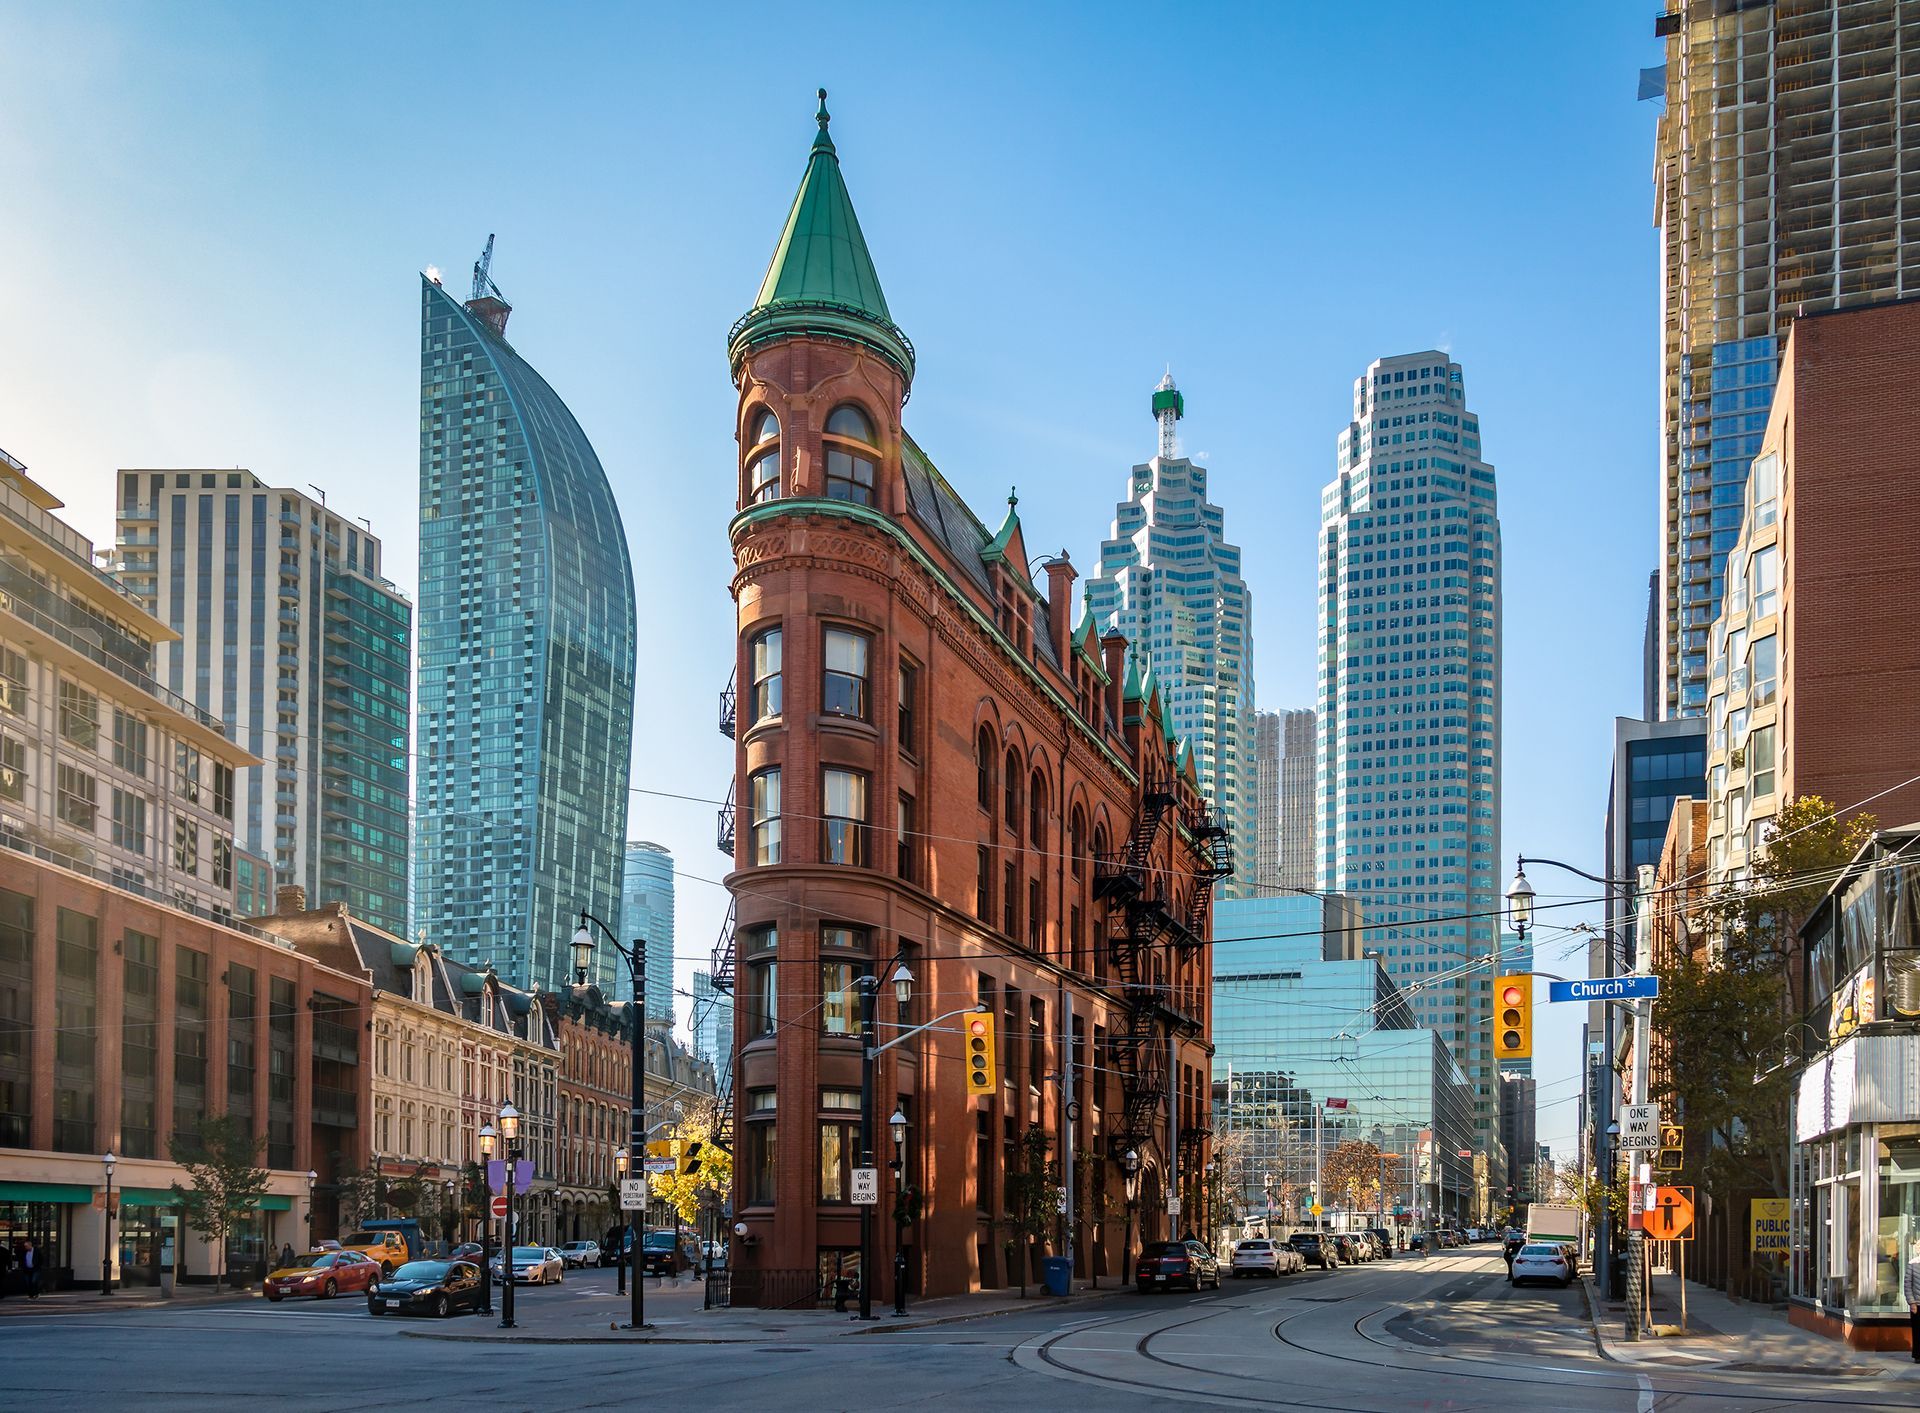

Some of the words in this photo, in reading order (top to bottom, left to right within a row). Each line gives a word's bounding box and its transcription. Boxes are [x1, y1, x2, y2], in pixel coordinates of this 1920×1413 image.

[1570, 980, 1623, 996] Church
[1627, 979, 1636, 987] St
[1629, 1107, 1649, 1119] ONE
[1629, 1121, 1649, 1133] WAY
[1622, 1135, 1657, 1147] BEGINS
[858, 1172, 870, 1180] ONE
[630, 1182, 638, 1191] NO
[1756, 1220, 1790, 1232] PUBLIC
